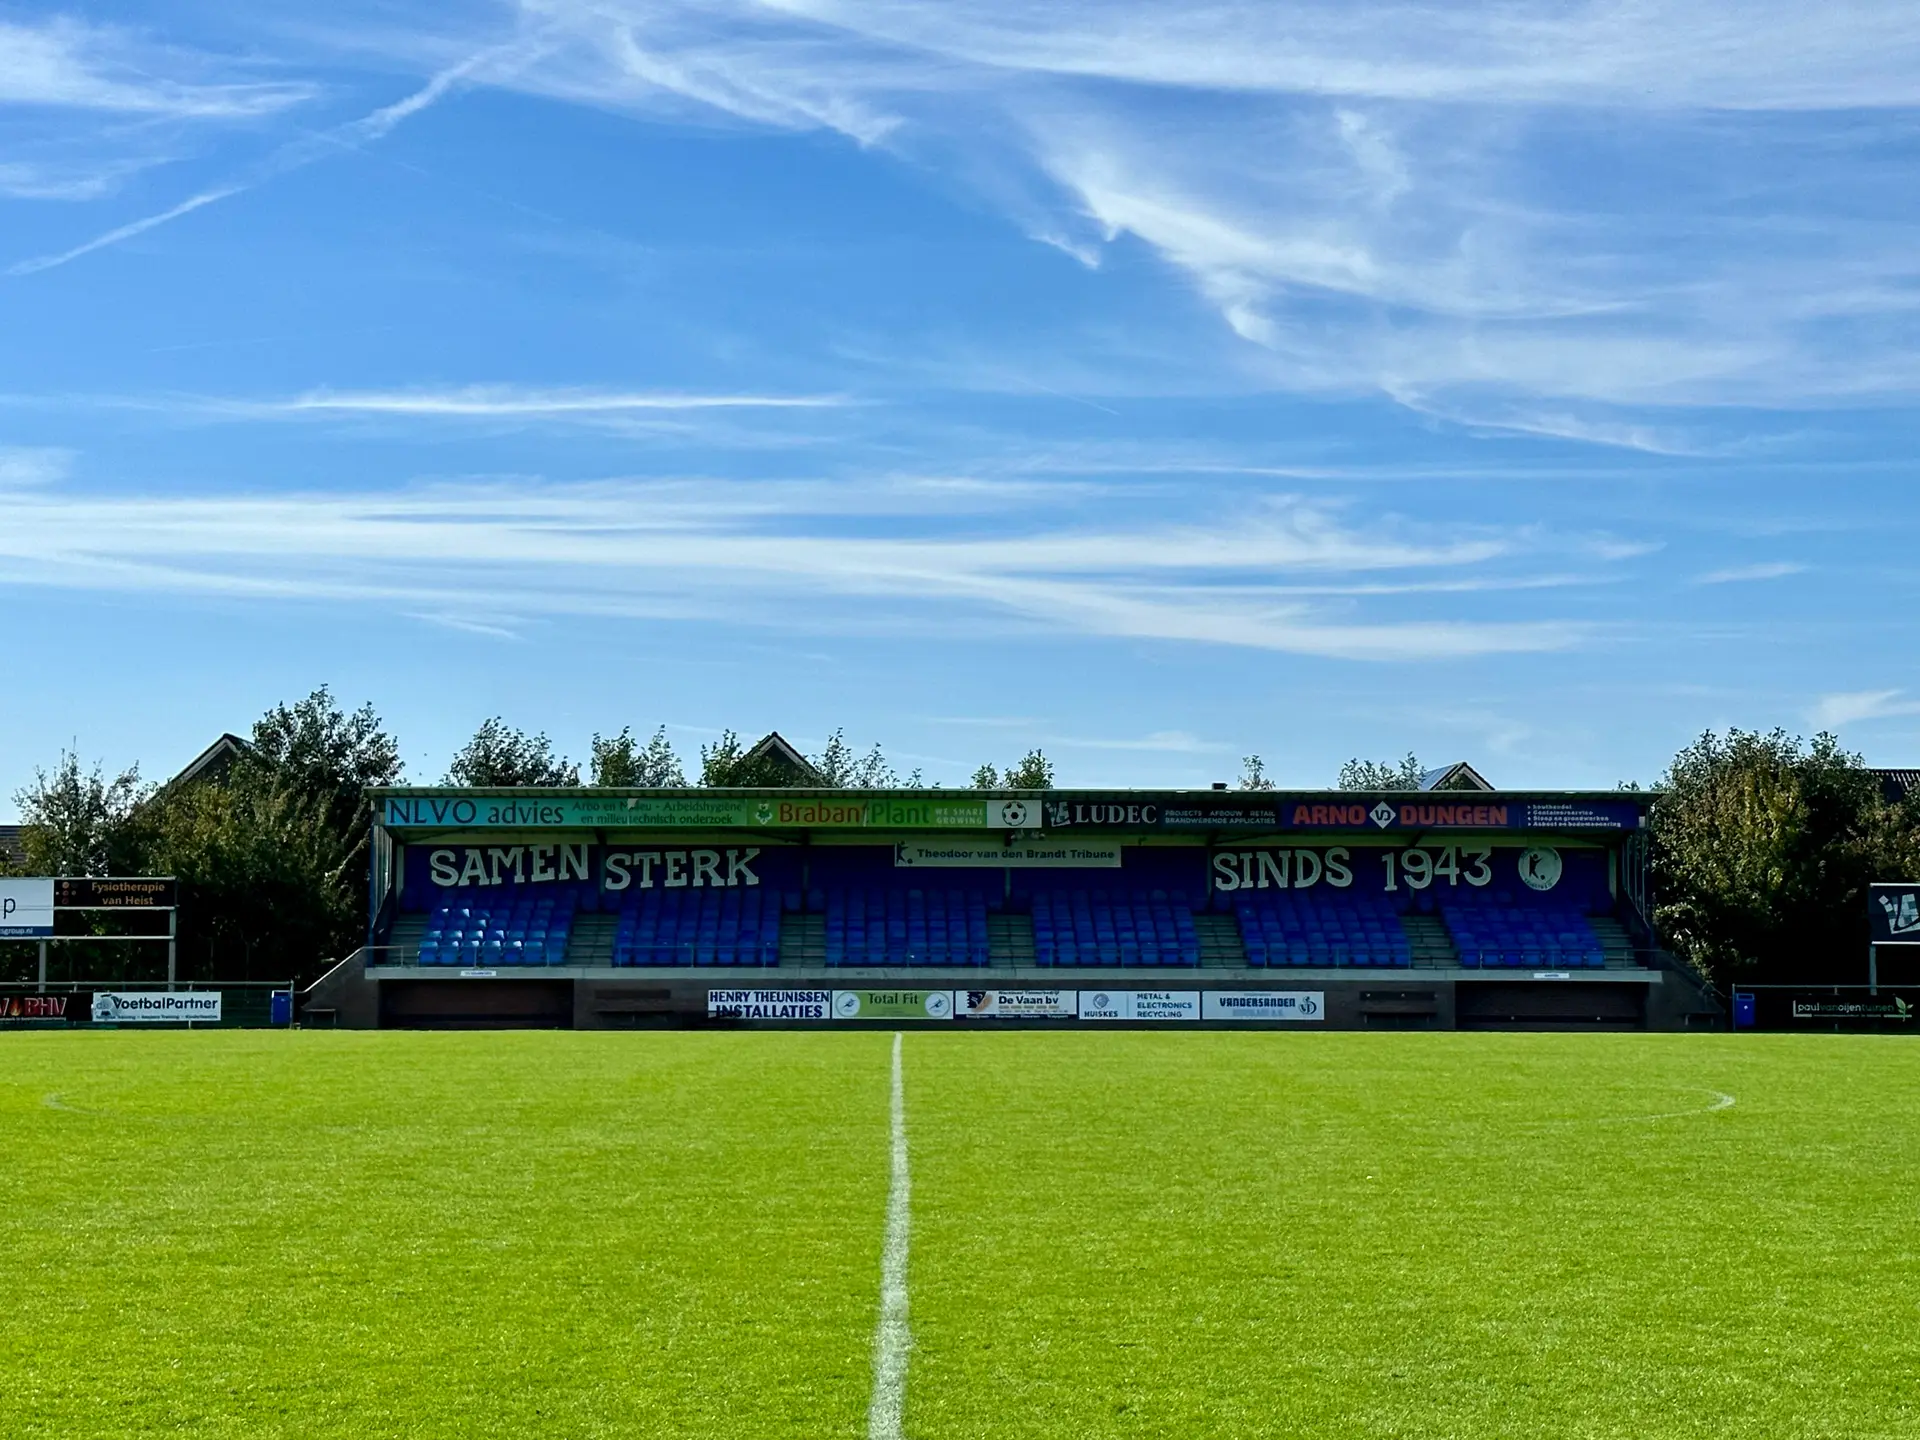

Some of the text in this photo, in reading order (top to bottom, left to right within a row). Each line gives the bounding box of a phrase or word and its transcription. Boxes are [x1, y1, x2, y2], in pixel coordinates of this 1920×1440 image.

[388, 799, 563, 824] NLVO advies
[572, 801, 600, 811] Arbo
[604, 803, 616, 811] en
[935, 807, 983, 816] WE SHARE
[581, 814, 594, 824] en
[679, 813, 733, 824] onderzoek
[1074, 804, 1157, 824] LUDEC
[1292, 805, 1367, 825] ARNO
[1399, 805, 1508, 825] DUNGEN
[936, 816, 983, 825] GROWING
[917, 848, 1115, 859] Theodoor van den Brandt Tribune
[430, 844, 760, 891] SAMEN STERK
[1212, 845, 1492, 891] SINDS 1943
[91, 882, 166, 895] Fysiotherapie
[102, 896, 155, 905] van Heist
[710, 991, 829, 1002] HENRY THEUNISSEN
[868, 993, 918, 1005] Total Fit
[998, 996, 1058, 1004] De Vaan bv
[24, 997, 67, 1016] BHV
[111, 997, 218, 1009] VoetbalPartner
[716, 1005, 823, 1018] INSTALLATIES
[1084, 1010, 1118, 1018] HUISKES
[1137, 1010, 1182, 1018] RECYCLING
